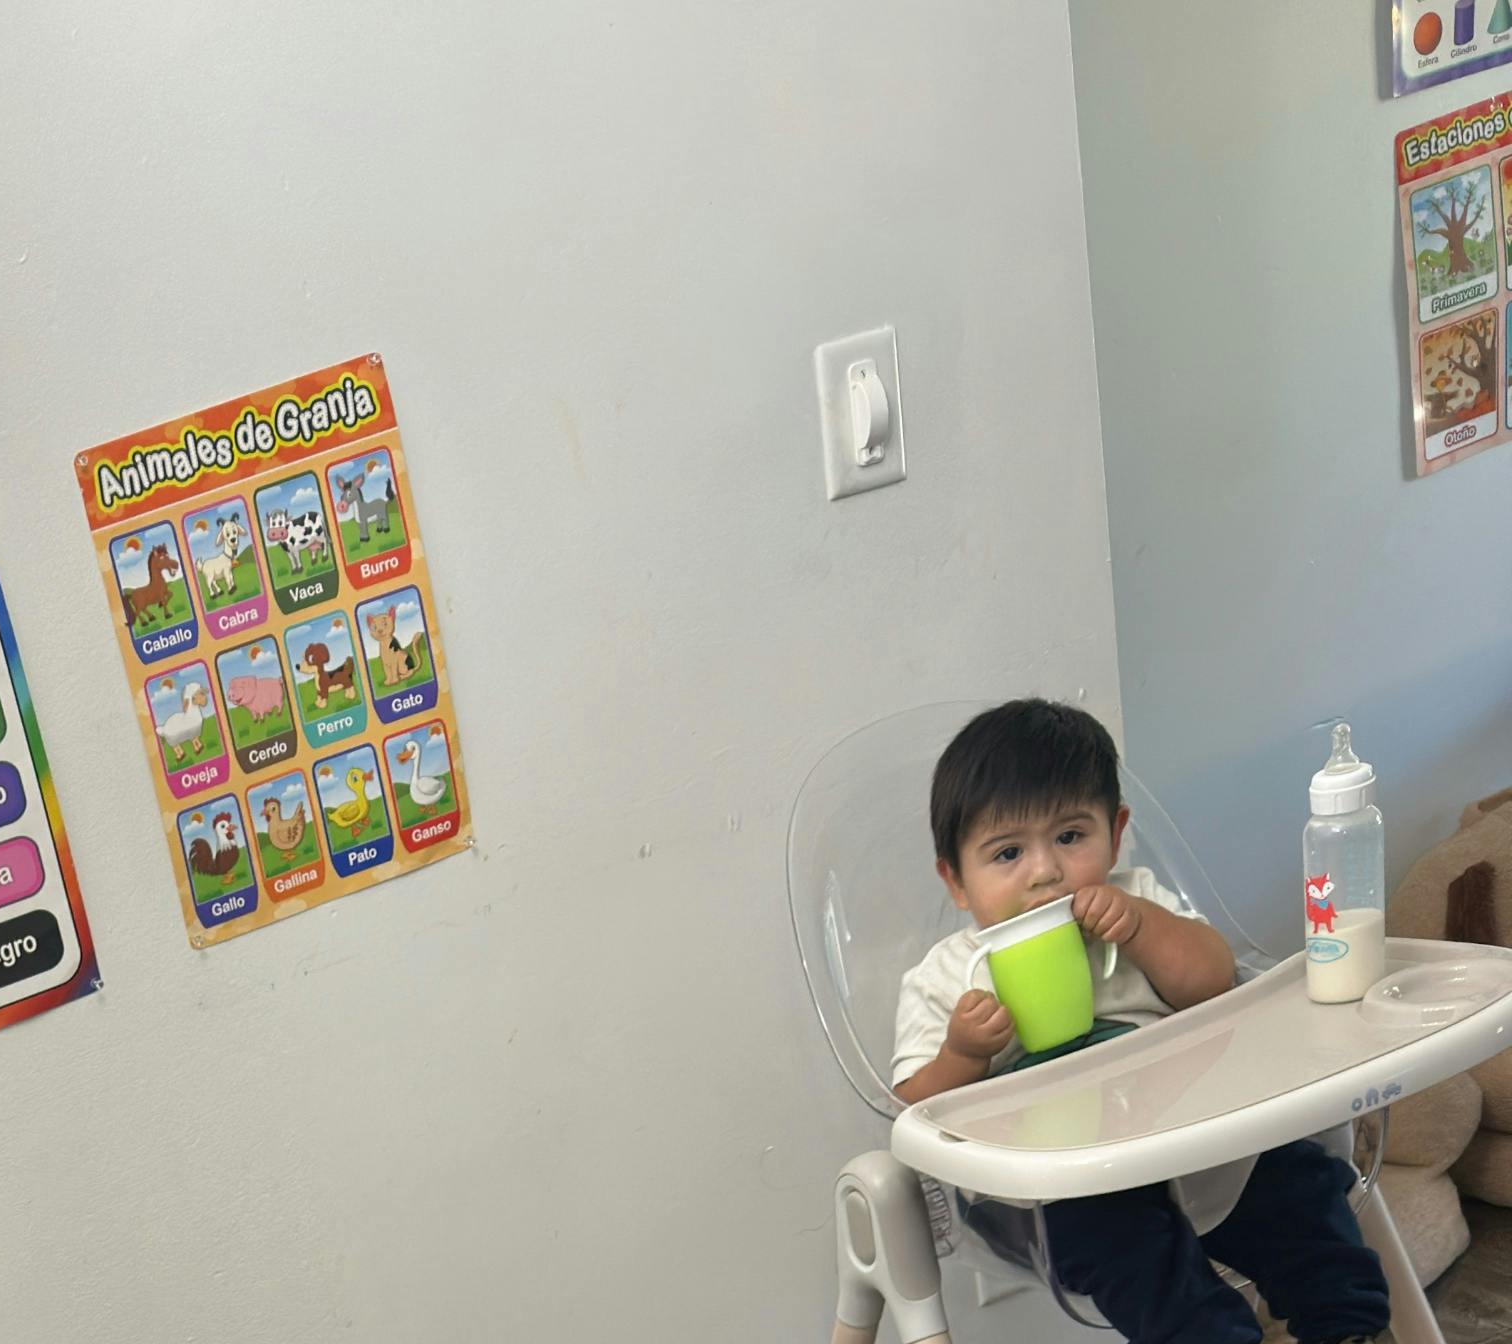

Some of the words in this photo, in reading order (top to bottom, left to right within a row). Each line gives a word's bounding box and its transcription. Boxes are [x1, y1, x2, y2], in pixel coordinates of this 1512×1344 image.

[1405, 112, 1506, 167] Estaciones
[1431, 282, 1487, 314] Primavera
[96, 429, 235, 508] Animales
[234, 410, 276, 453] de
[274, 376, 377, 441] Granja
[1444, 425, 1477, 447] Otoño
[359, 556, 399, 579] Burro
[289, 582, 324, 603] Vaca
[219, 605, 259, 631] Cabra
[142, 626, 194, 654] Caballo
[391, 692, 424, 713] Gato
[317, 715, 353, 737] Perro
[248, 741, 288, 765] Cerdo
[181, 765, 219, 790] Oveja
[411, 819, 452, 844] Ganso
[348, 846, 378, 867] Pato
[273, 867, 318, 894] Gallina
[211, 895, 246, 918] Gallo
